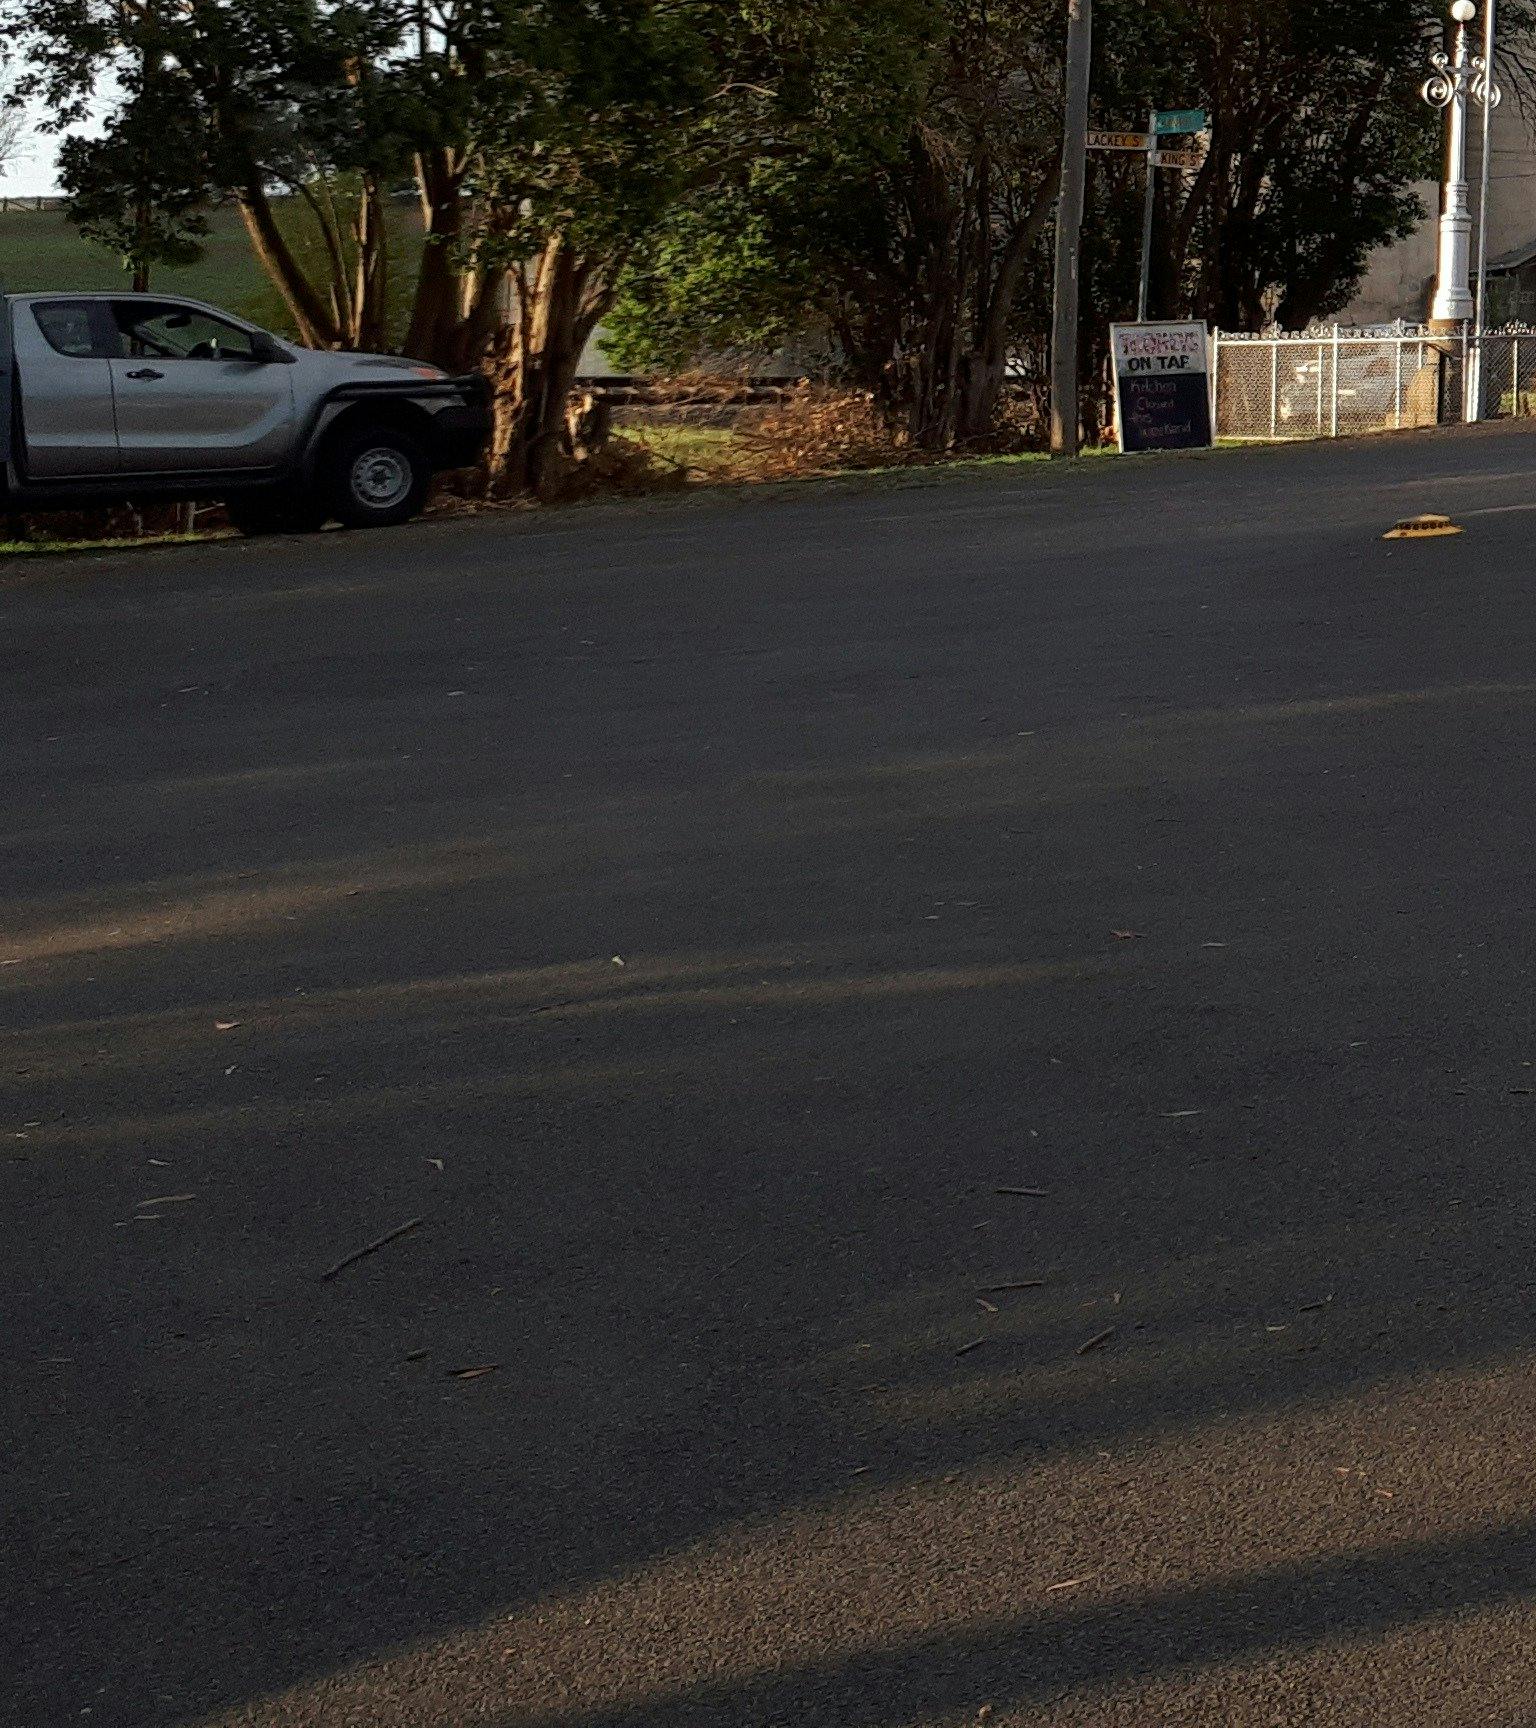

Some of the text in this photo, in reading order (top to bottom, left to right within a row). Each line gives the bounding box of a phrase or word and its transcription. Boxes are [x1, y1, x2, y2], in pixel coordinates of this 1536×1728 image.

[1086, 132, 1126, 147] LACKEY
[1160, 152, 1186, 166] KING
[1128, 355, 1190, 371] ON TAP
